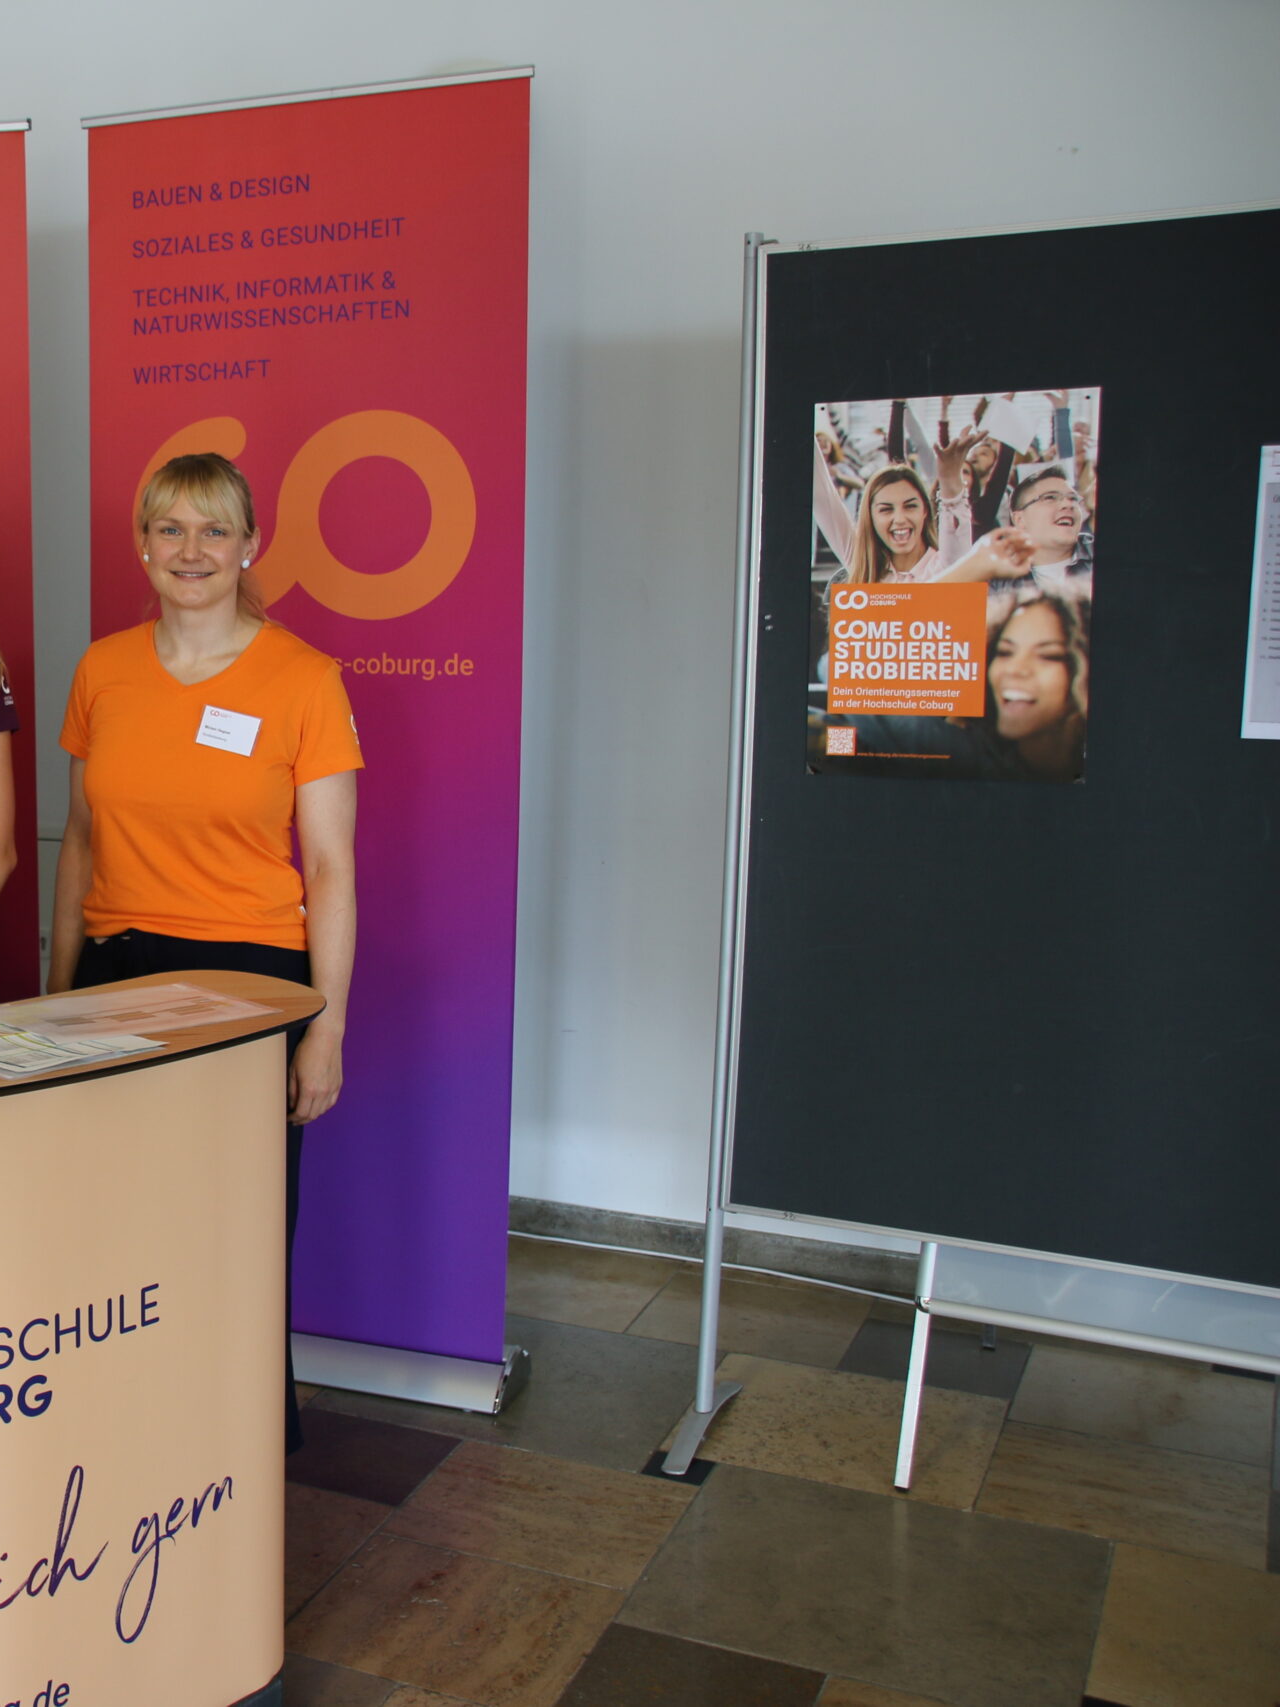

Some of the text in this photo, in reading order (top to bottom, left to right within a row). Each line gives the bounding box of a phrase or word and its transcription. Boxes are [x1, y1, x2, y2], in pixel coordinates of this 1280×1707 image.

[132, 174, 311, 209] BAUEN & DESIGN
[132, 217, 406, 259] SOZIALES & GESUNDHEIT
[133, 271, 396, 308] TECHNIK, INFORMATIK &
[133, 299, 411, 336] NATURWISSENSCHAFTEN
[134, 359, 272, 385] WIRTSCHAFT
[834, 590, 868, 610] CO
[833, 620, 951, 639] COME ON:
[834, 641, 969, 660] STUDIEREN
[833, 661, 978, 680] PROBIEREN!
[833, 686, 961, 699] Dein Orientierungssemester
[832, 699, 954, 712] an der Hochschule Coburg
[115, 1475, 234, 1644] gern
